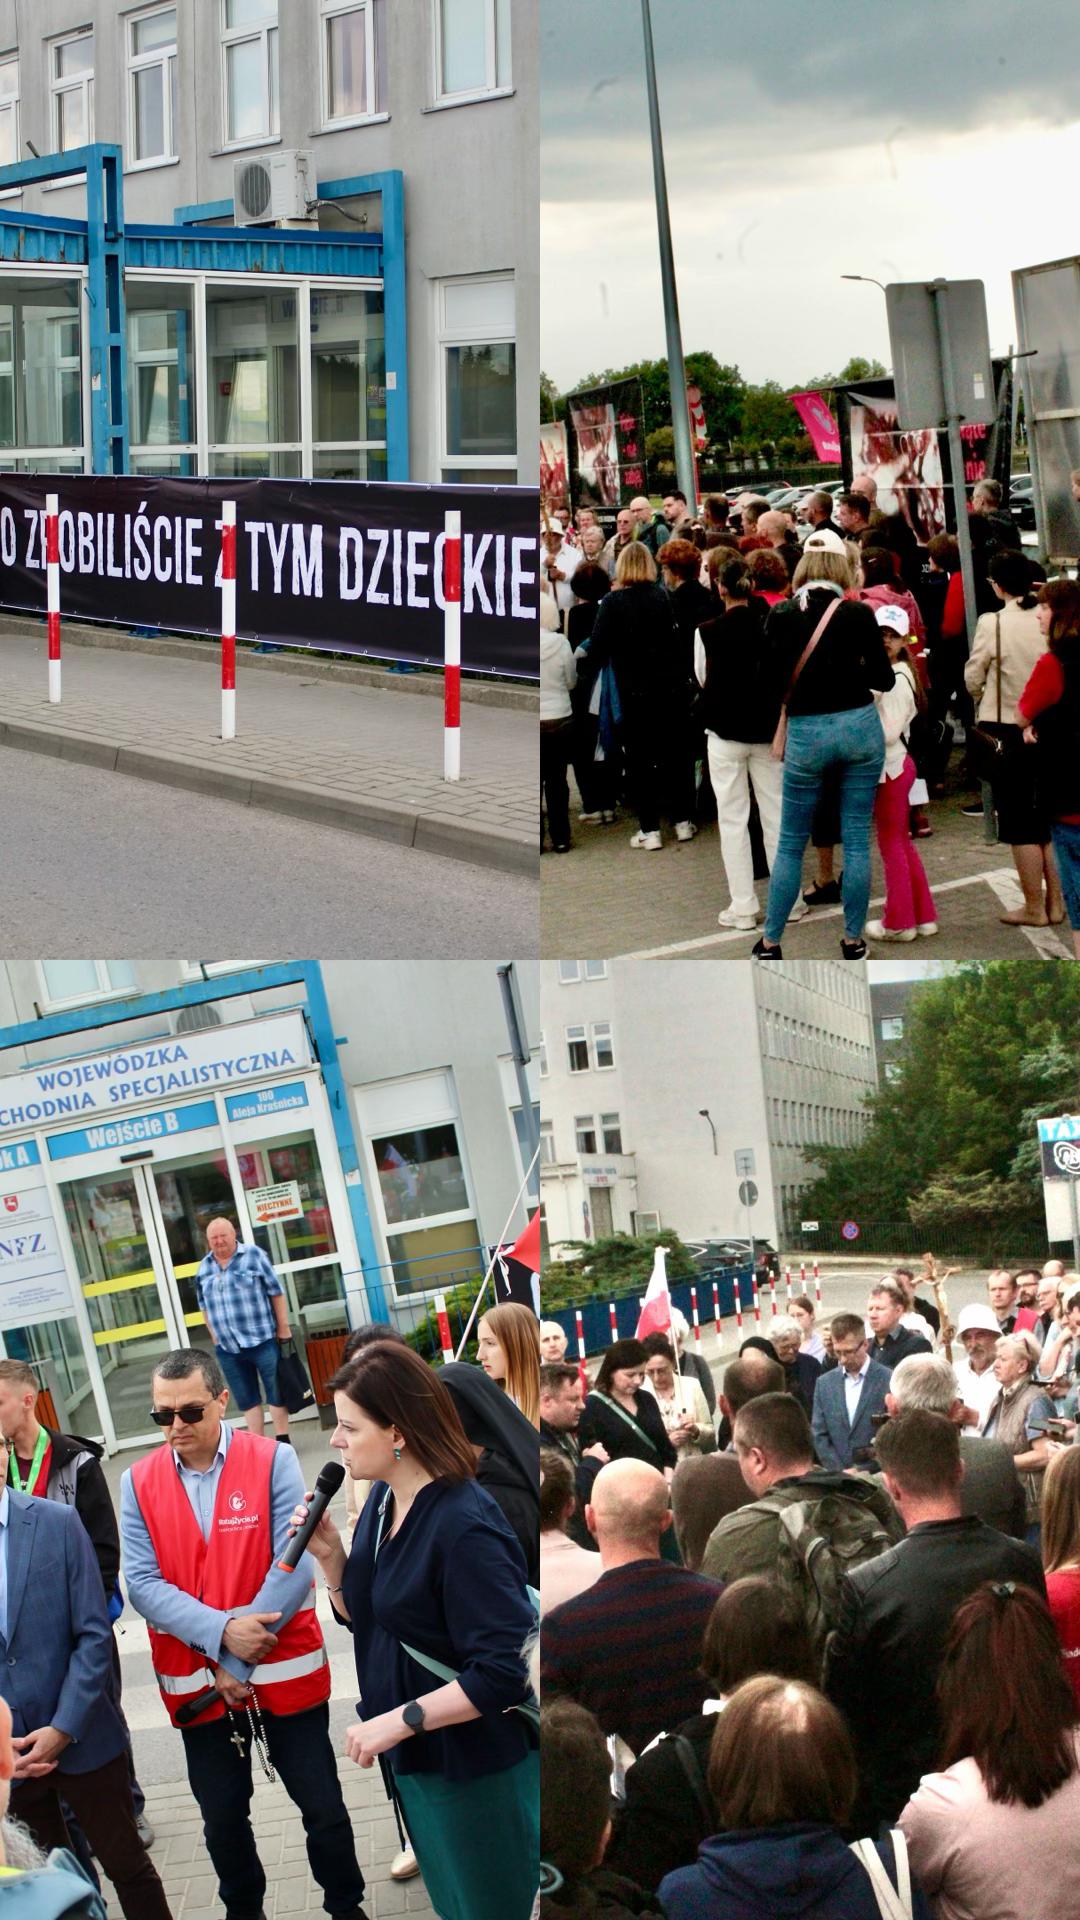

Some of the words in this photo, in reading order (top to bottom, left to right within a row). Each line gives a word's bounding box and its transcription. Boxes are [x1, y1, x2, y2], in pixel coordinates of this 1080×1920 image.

[1, 507, 16, 567] O
[244, 521, 323, 598] TYM
[0, 1092, 96, 1126] CHODNIA
[110, 1049, 296, 1102] SPECJALISTYCZNA
[37, 1045, 188, 1092] WOJEWÓDZKA
[86, 1117, 162, 1149] Wejście
[164, 1112, 179, 1132] B
[16, 1145, 31, 1166] A
[0, 1233, 46, 1260] NFZ
